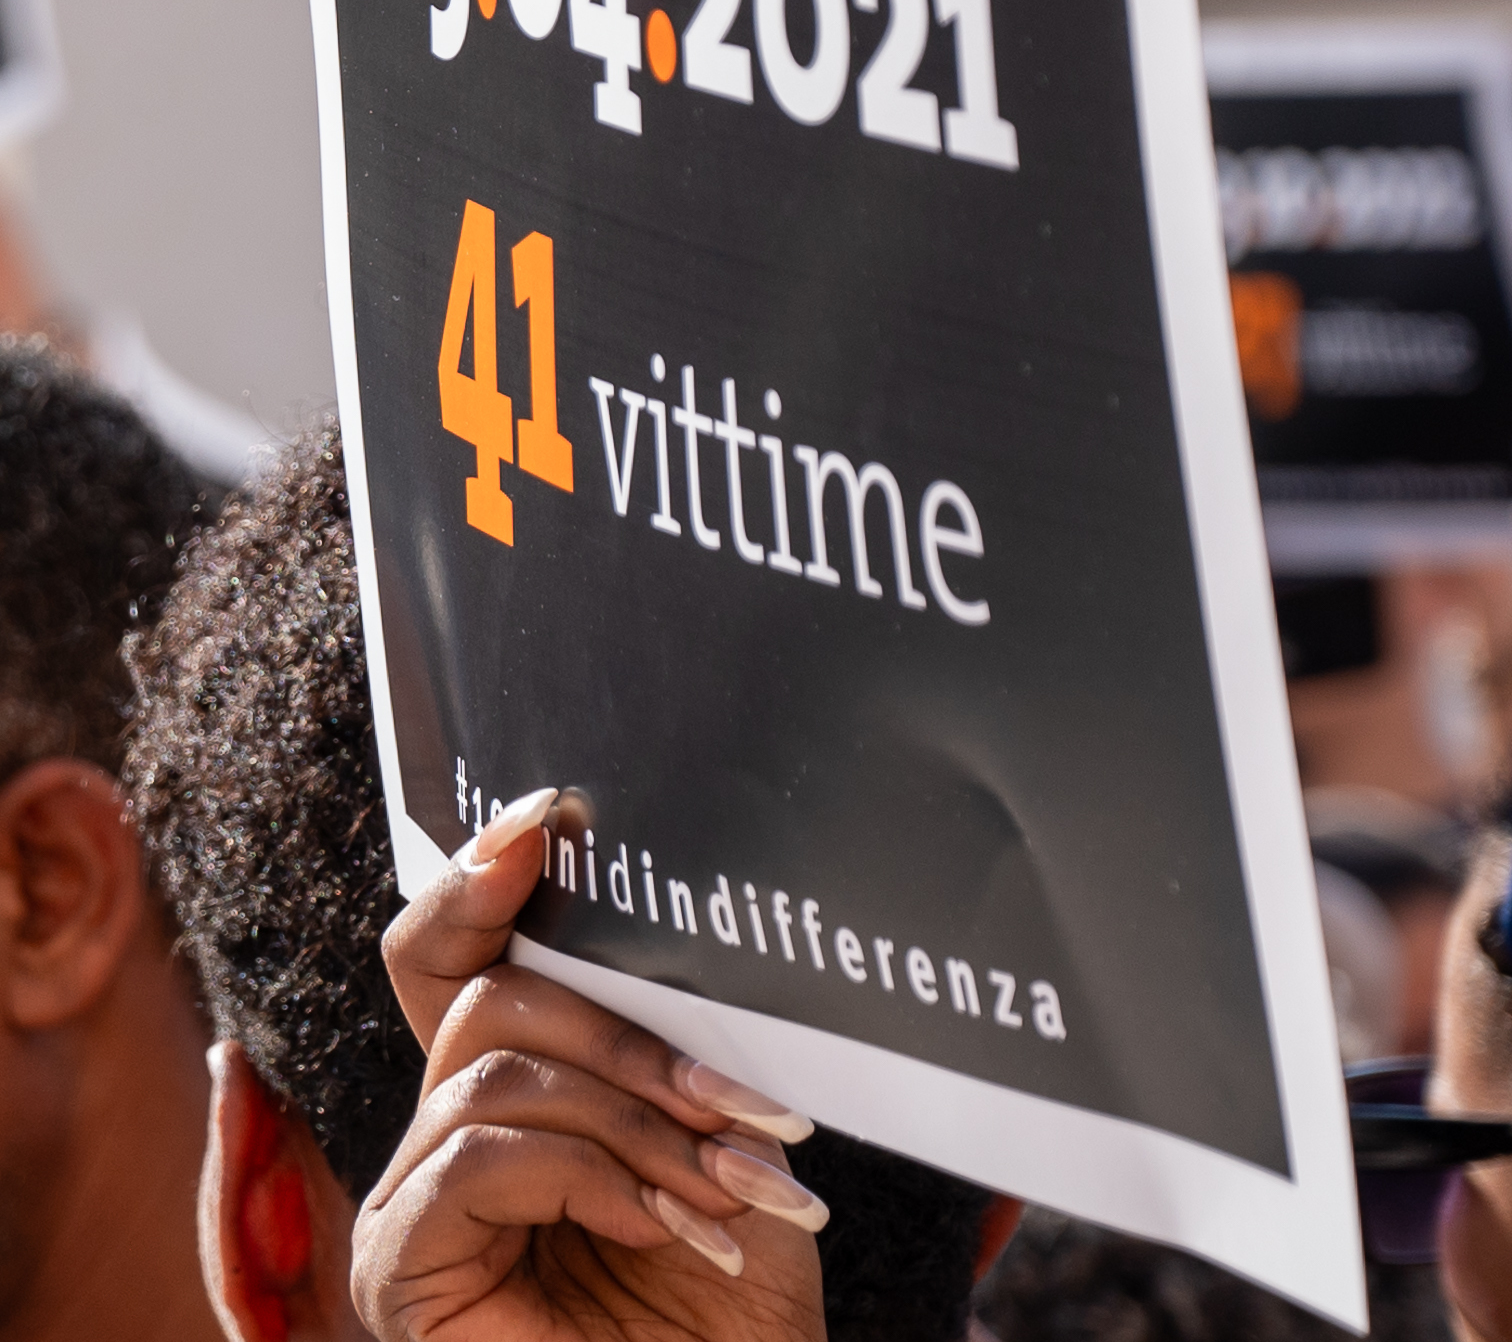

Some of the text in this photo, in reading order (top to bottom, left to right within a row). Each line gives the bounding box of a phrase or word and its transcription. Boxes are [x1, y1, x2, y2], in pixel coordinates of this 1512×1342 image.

[438, 199, 991, 626] 41 vittime
[456, 756, 1067, 1042] #1nidindifferenza
